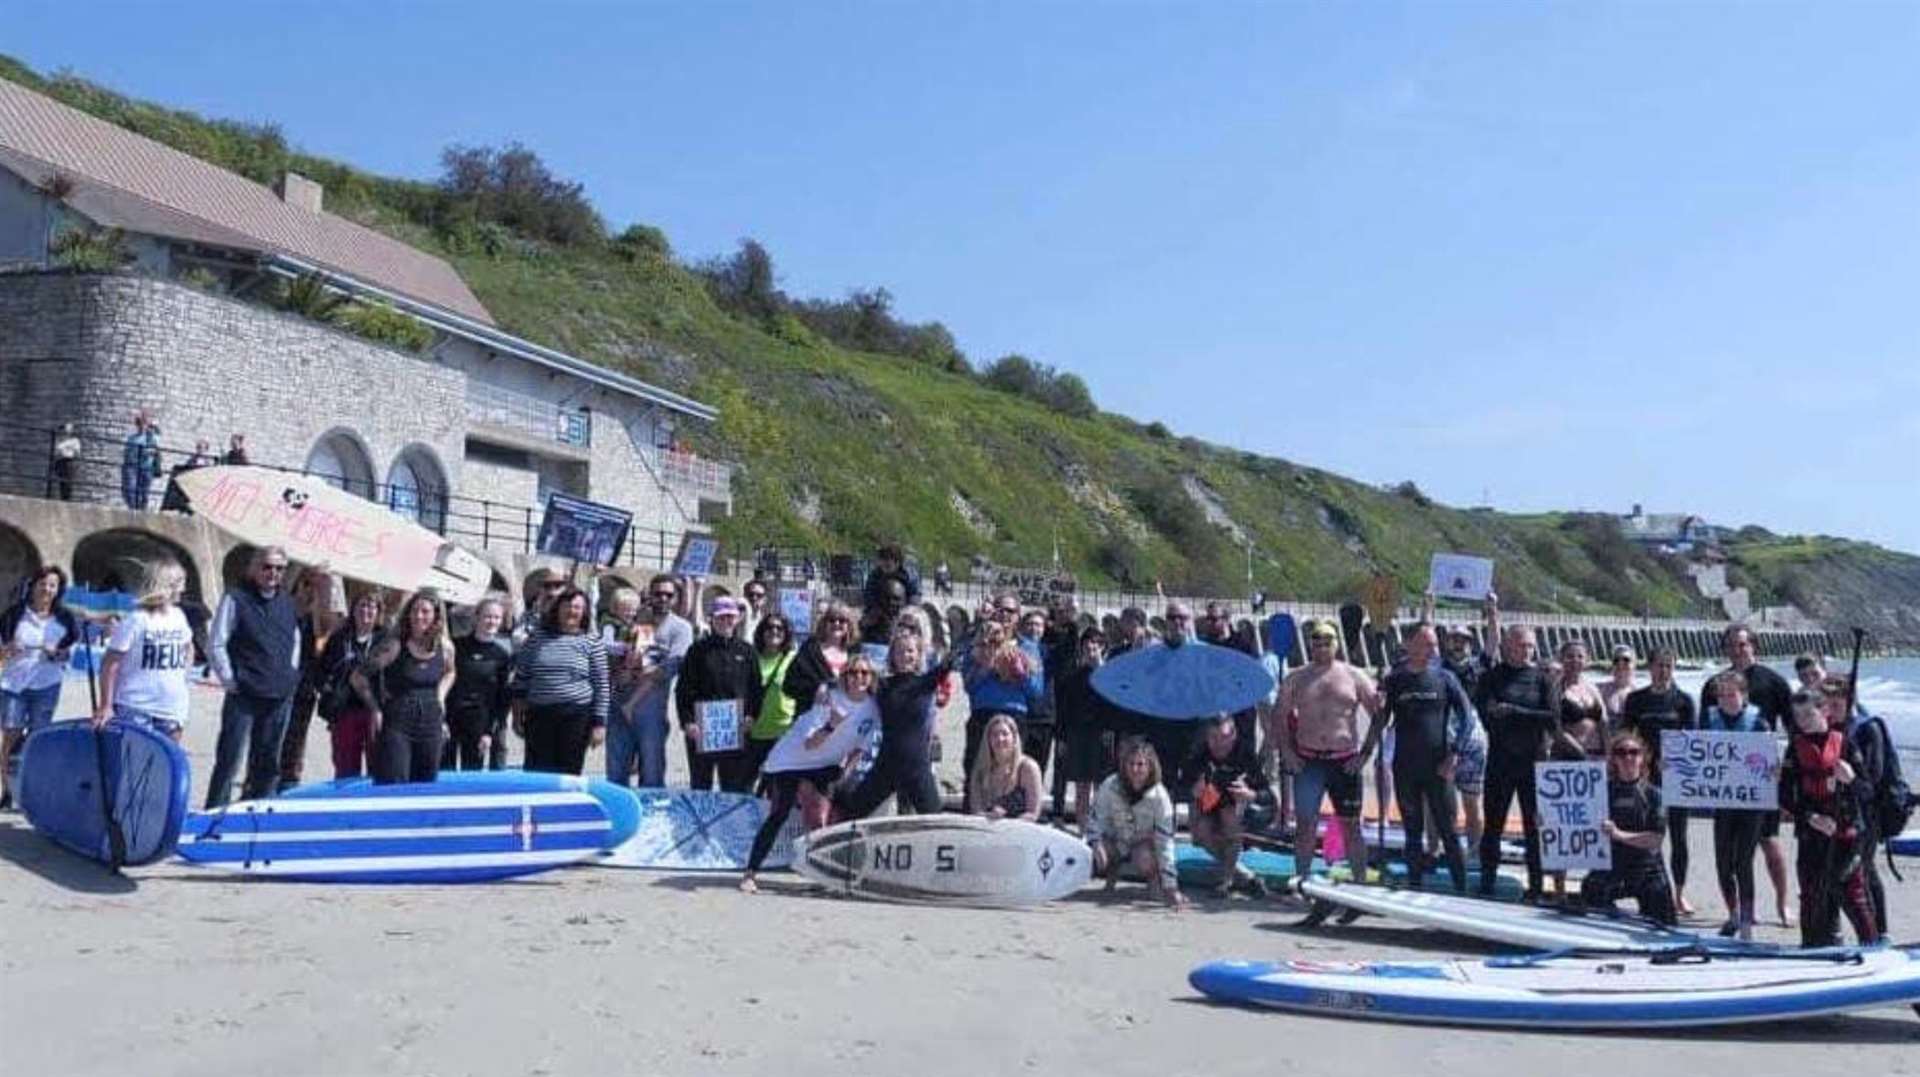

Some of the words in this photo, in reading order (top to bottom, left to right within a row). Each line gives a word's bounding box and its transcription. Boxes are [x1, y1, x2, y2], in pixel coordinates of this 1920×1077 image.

[205, 474, 262, 523] NO
[996, 573, 1045, 590] SAVE
[1689, 739, 1741, 763] SICK
[1539, 768, 1602, 799] STOP
[1703, 765, 1729, 780] OF
[1681, 781, 1762, 801] SEWAGE
[1553, 803, 1589, 824] THE
[873, 845, 912, 870] NO
